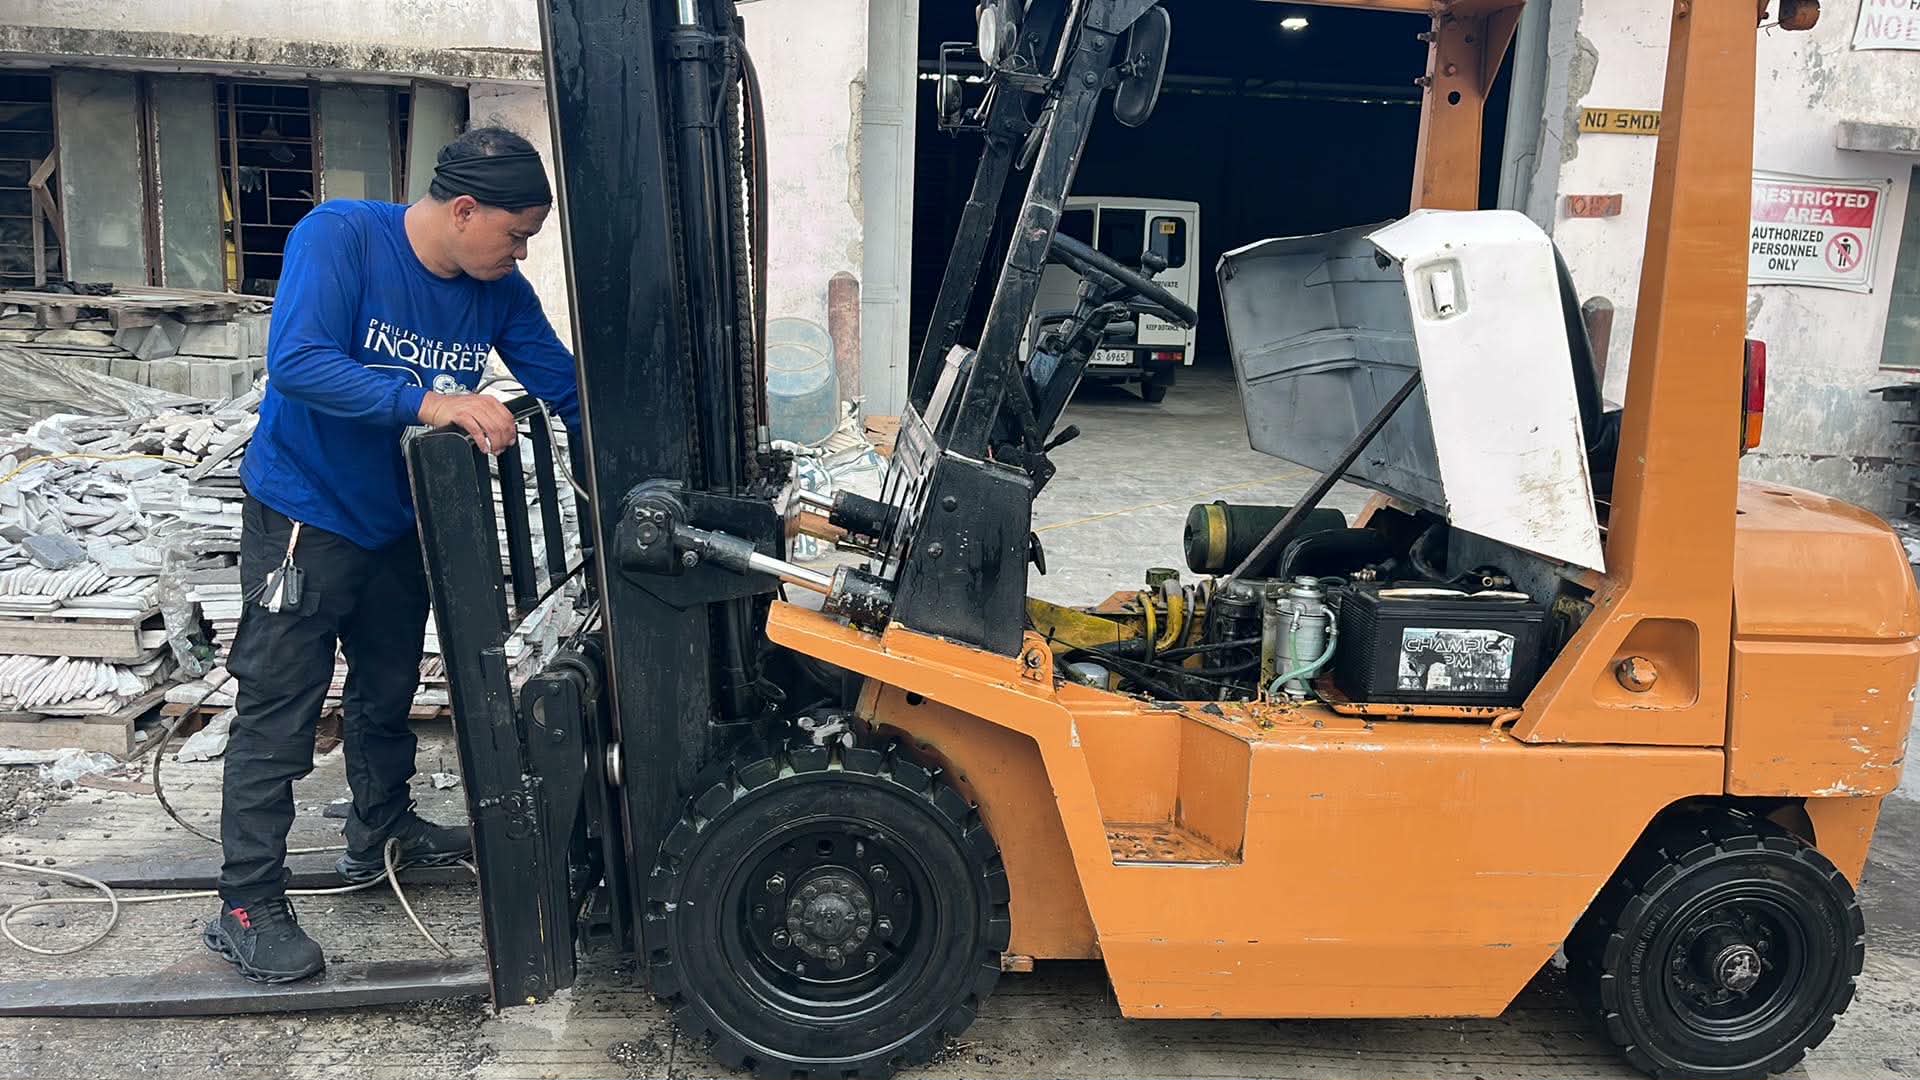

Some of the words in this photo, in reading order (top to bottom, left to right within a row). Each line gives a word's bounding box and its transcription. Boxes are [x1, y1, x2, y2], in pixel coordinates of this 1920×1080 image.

[1585, 111, 1608, 128] NO
[1783, 207, 1834, 224] AREA
[1751, 226, 1824, 243] AUTHORIZED
[1751, 242, 1819, 258] PERSONNEL
[1768, 258, 1799, 271] ONLY
[364, 327, 488, 372] INQUIRER
